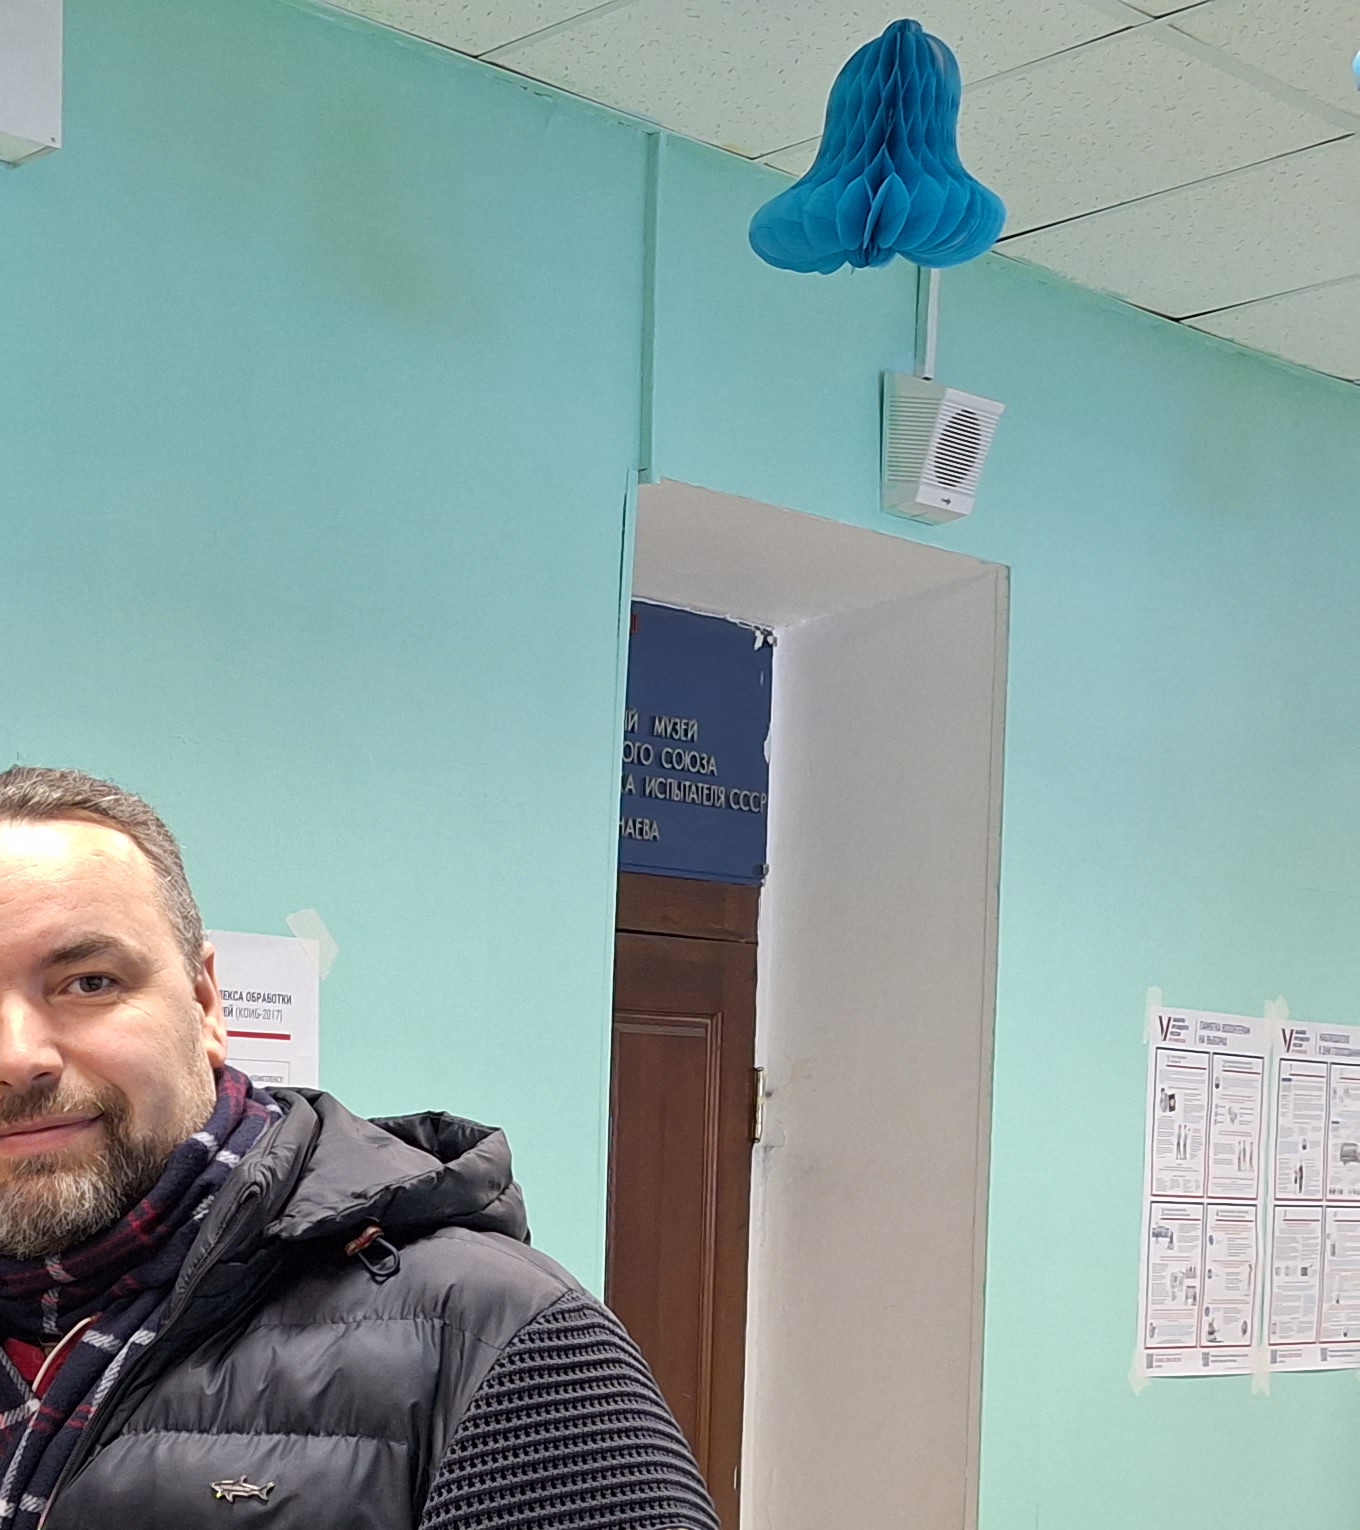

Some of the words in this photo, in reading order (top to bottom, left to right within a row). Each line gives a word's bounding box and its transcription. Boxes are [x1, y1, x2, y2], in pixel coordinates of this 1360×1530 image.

[653, 715, 698, 742] МУЗЕЙ
[623, 741, 654, 766] ОГО
[661, 748, 718, 777] СОЮЗА
[645, 776, 725, 808] ИСПЫТАТЕЛЯ
[729, 789, 767, 813] СССР
[246, 992, 292, 1005] ОБРАБОТКИ
